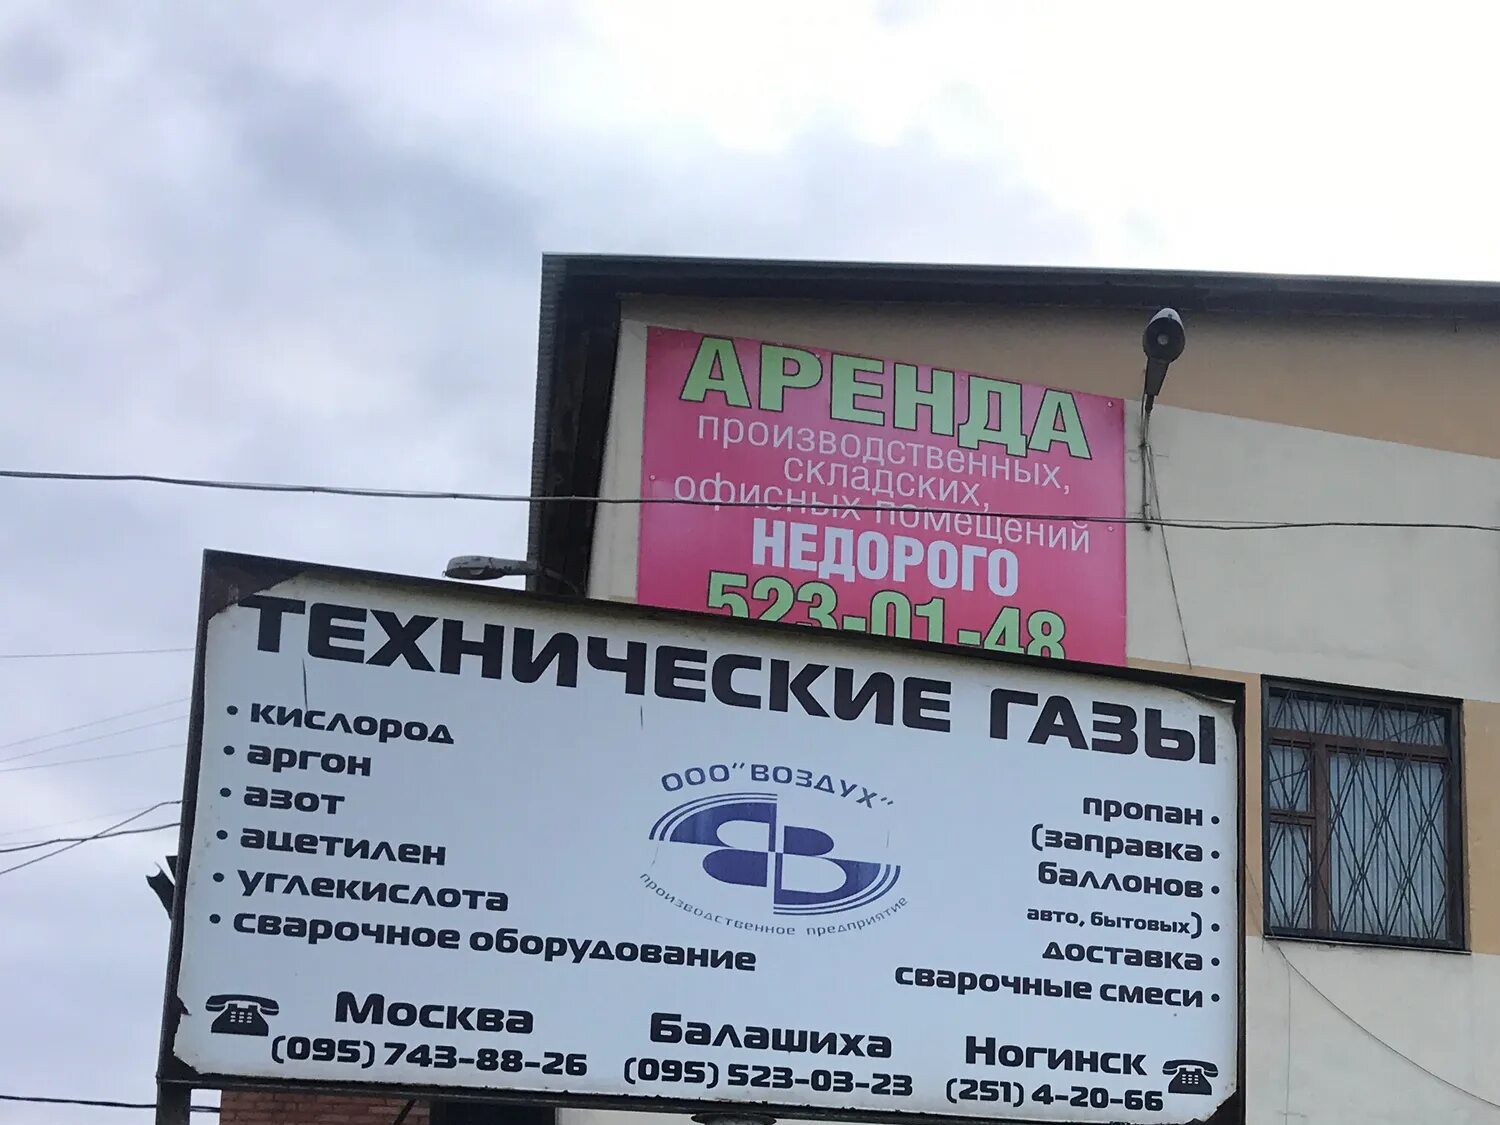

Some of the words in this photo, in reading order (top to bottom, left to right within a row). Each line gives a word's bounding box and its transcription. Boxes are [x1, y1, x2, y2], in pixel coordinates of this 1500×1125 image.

[680, 336, 1092, 460] АРЕНДА
[698, 415, 1070, 496] производственных,
[784, 456, 989, 512] складских,
[674, 472, 861, 521] офисных
[875, 505, 1090, 553] помещений
[753, 517, 1018, 597] НЕДОРОГО
[238, 594, 951, 733] ТЕХНИЧЕСКИЕ
[990, 688, 1216, 765] ГАЗЫ
[251, 703, 454, 744] кислород
[247, 744, 371, 776] аргон
[243, 785, 345, 815] азот
[1083, 797, 1203, 826] пропан
[240, 826, 446, 865] ацетилен
[1032, 823, 1203, 863] (заправка
[238, 869, 508, 912] углекислота
[1038, 861, 1203, 898] баллонов
[639, 872, 796, 935] производственное
[806, 896, 908, 937] предприятие
[1027, 908, 1085, 928] авто,
[1091, 911, 1202, 938] бытовых)
[233, 912, 459, 949] сварочное
[470, 930, 757, 972] оборудование
[1042, 941, 1203, 971] доставка
[895, 965, 1092, 1000] сварочные
[1100, 983, 1203, 1008] смеси
[335, 991, 533, 1034] Москва
[650, 1011, 892, 1058] Балашиха
[965, 1036, 1147, 1076] Ногинск
